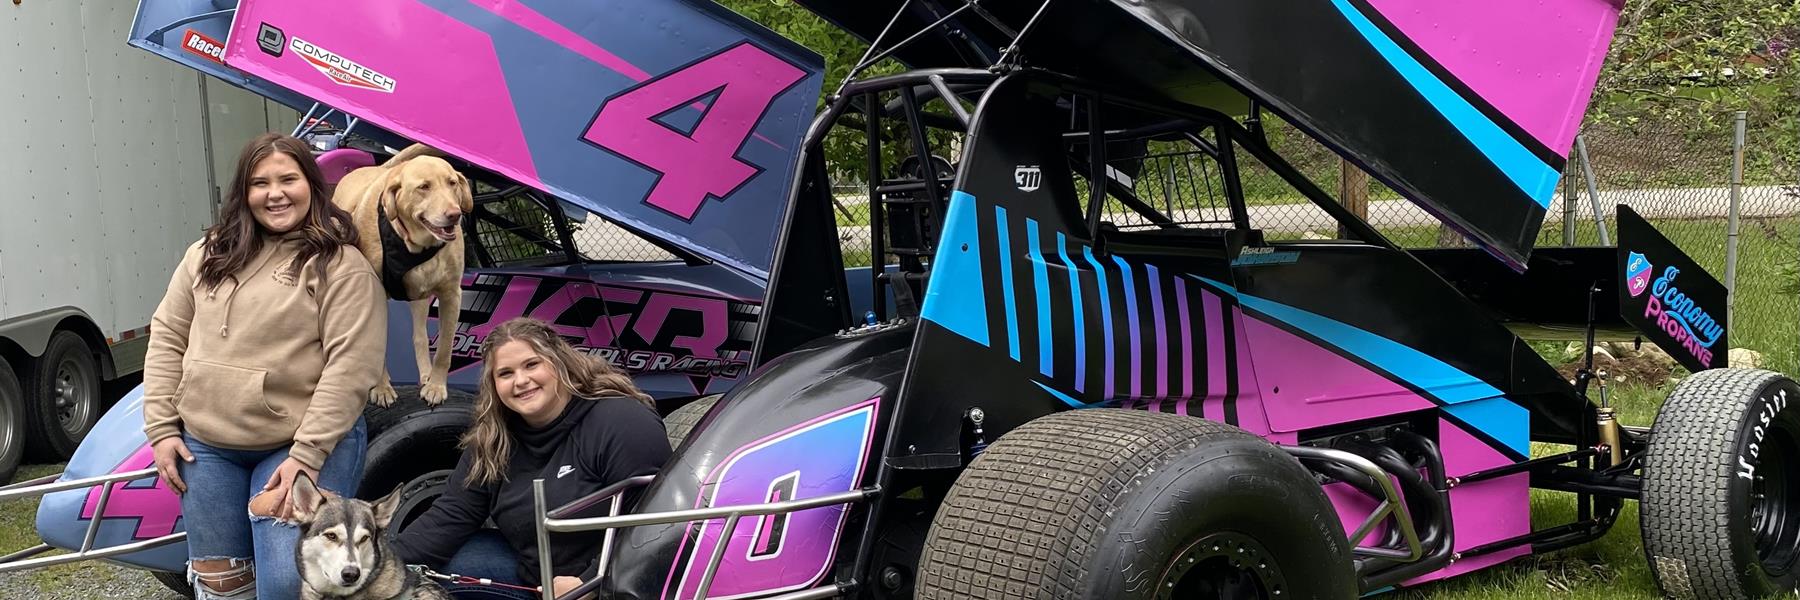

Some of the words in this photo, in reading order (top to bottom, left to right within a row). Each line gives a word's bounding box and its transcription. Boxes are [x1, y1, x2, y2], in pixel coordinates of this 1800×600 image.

[291, 38, 395, 90] COMPUTECH
[577, 38, 816, 225] 4
[1016, 170, 1040, 188] 311
[1645, 294, 1713, 369] PROPANE
[1652, 266, 1724, 348] Economy
